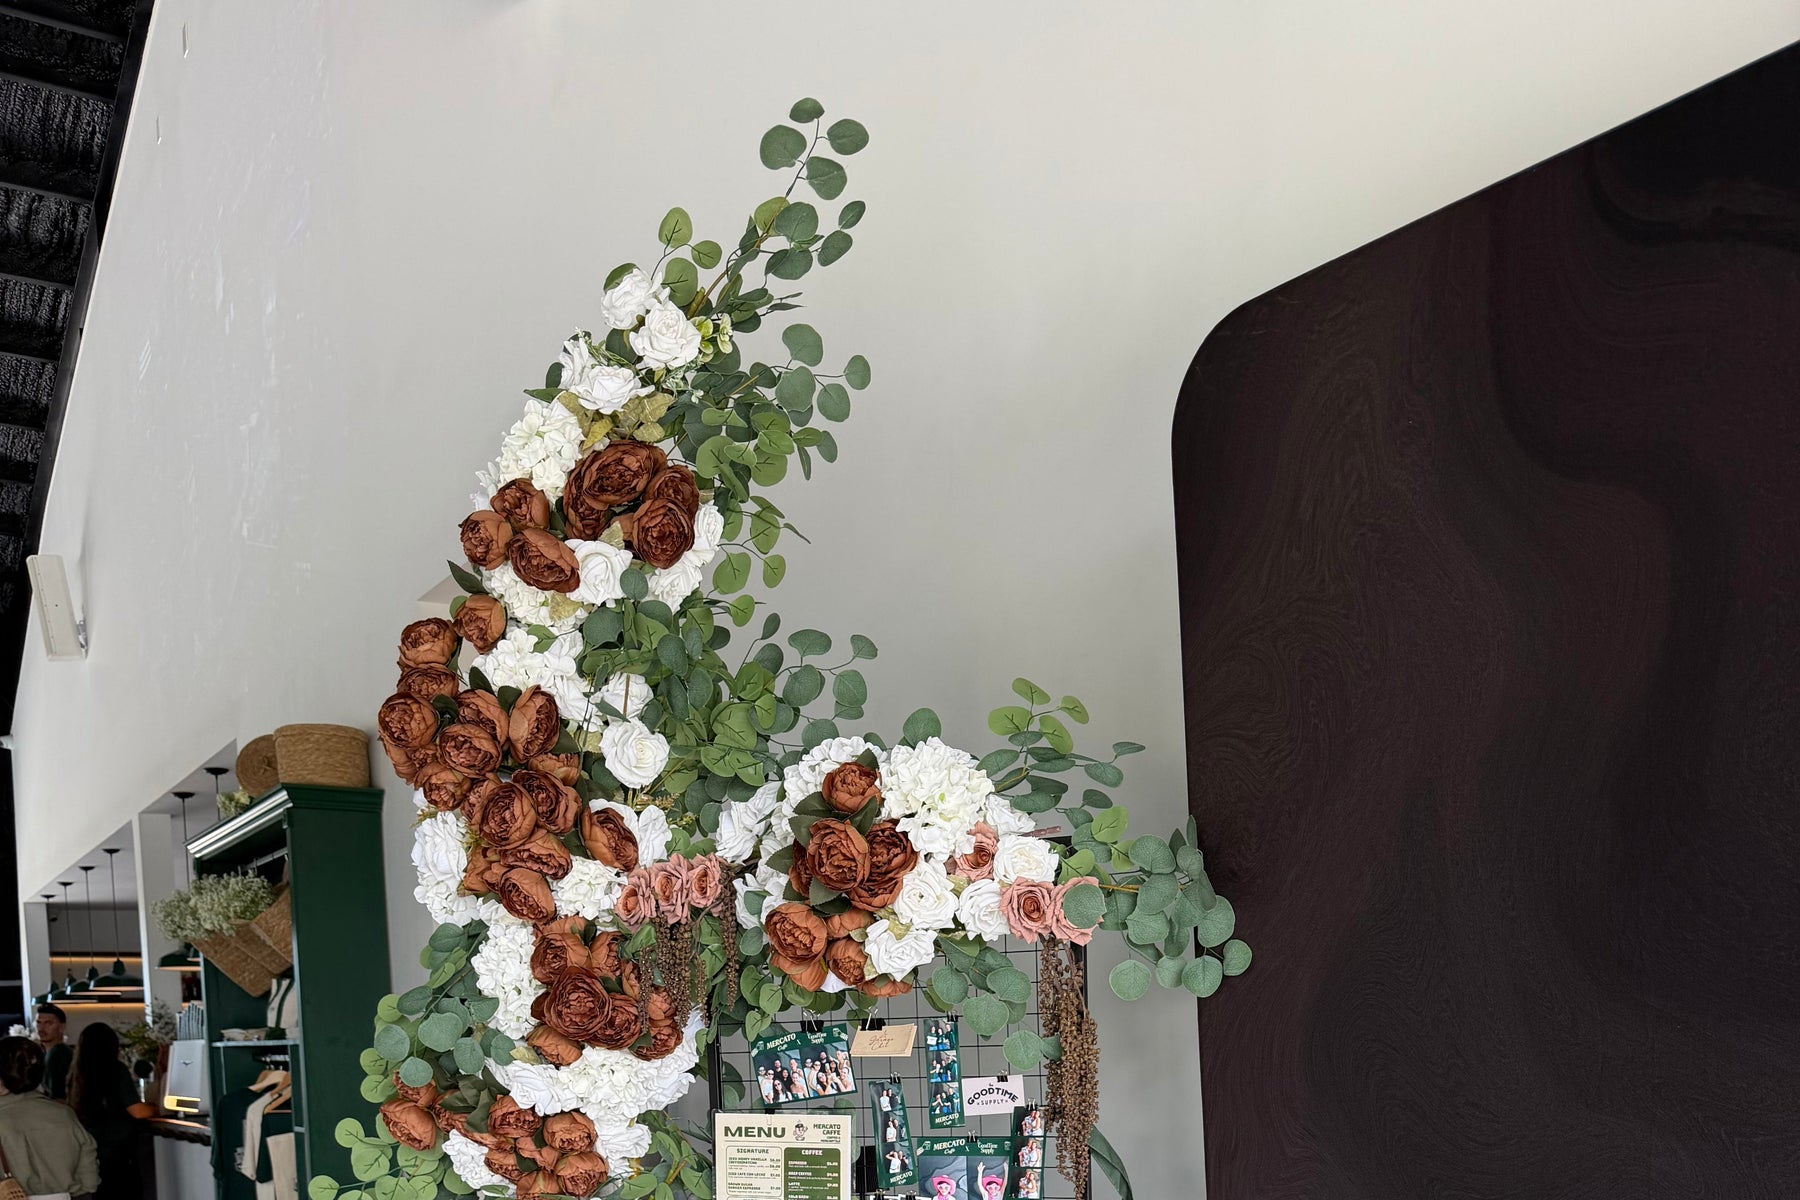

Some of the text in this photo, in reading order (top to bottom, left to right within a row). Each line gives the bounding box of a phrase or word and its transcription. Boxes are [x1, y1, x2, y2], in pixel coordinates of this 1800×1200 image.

[766, 1033, 796, 1050] MERCATO
[967, 1087, 1019, 1105] GOODTIME
[935, 1112, 960, 1124] MERCATO
[723, 1126, 786, 1138] MENU
[933, 1138, 965, 1151] MERCATO
[890, 1171, 913, 1184] MERCATO
